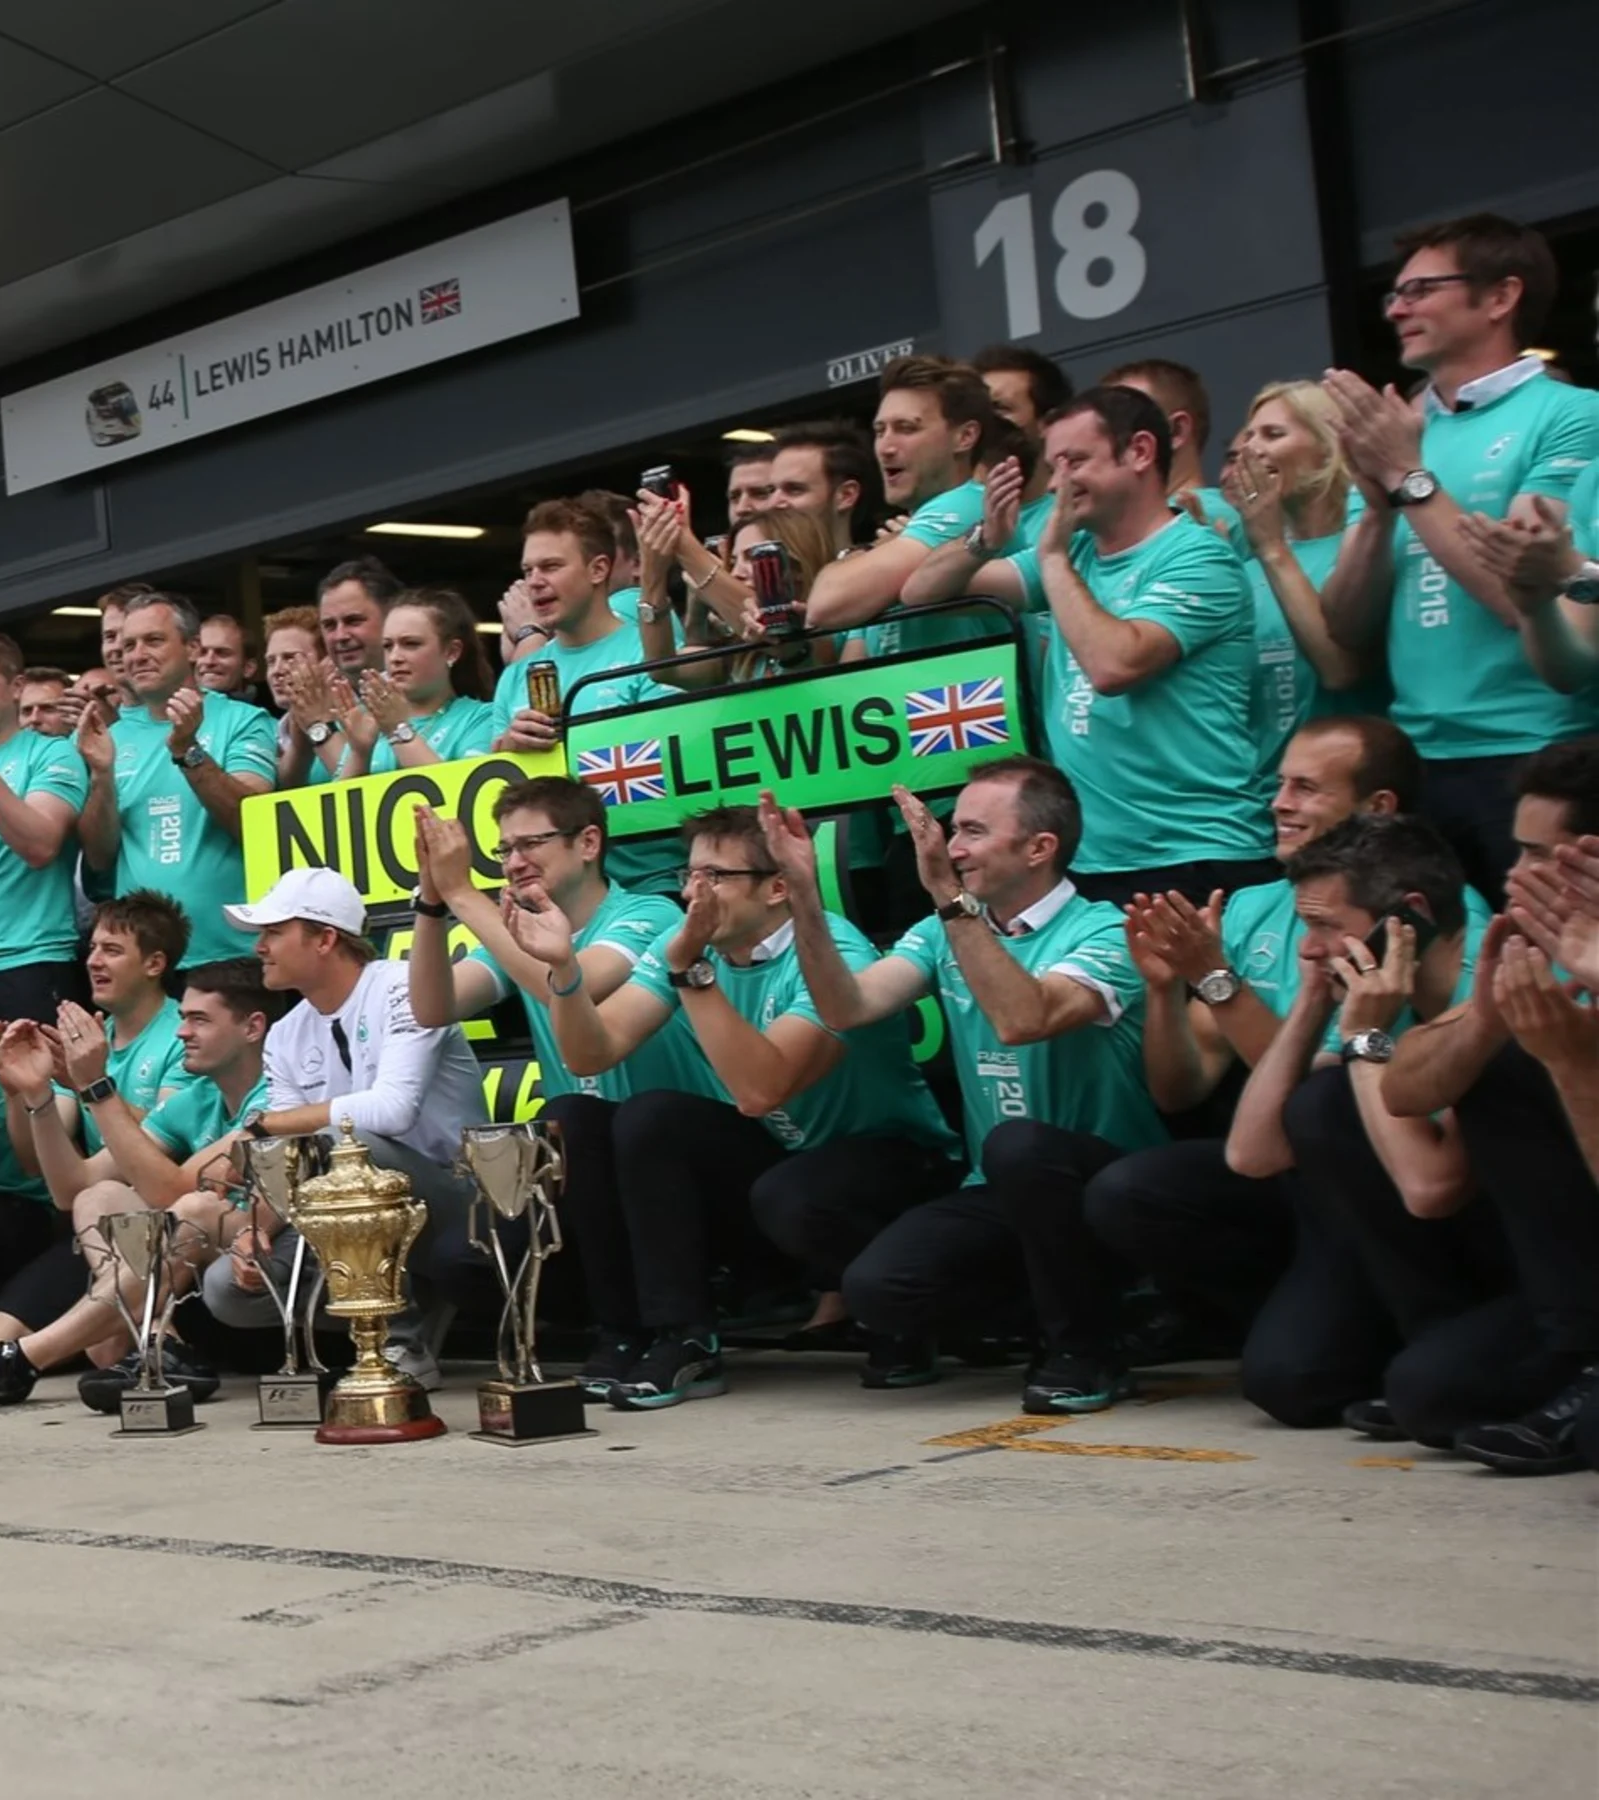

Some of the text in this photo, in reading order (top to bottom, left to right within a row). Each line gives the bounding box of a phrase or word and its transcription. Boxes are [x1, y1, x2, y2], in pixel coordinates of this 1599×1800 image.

[973, 168, 1148, 341] 18
[146, 297, 415, 411] 44 LEWIS HAMILTON
[668, 696, 901, 796] LEWIS
[160, 816, 182, 864] 2015
[274, 759, 531, 896] NICO
[977, 1050, 1019, 1065] RACE
